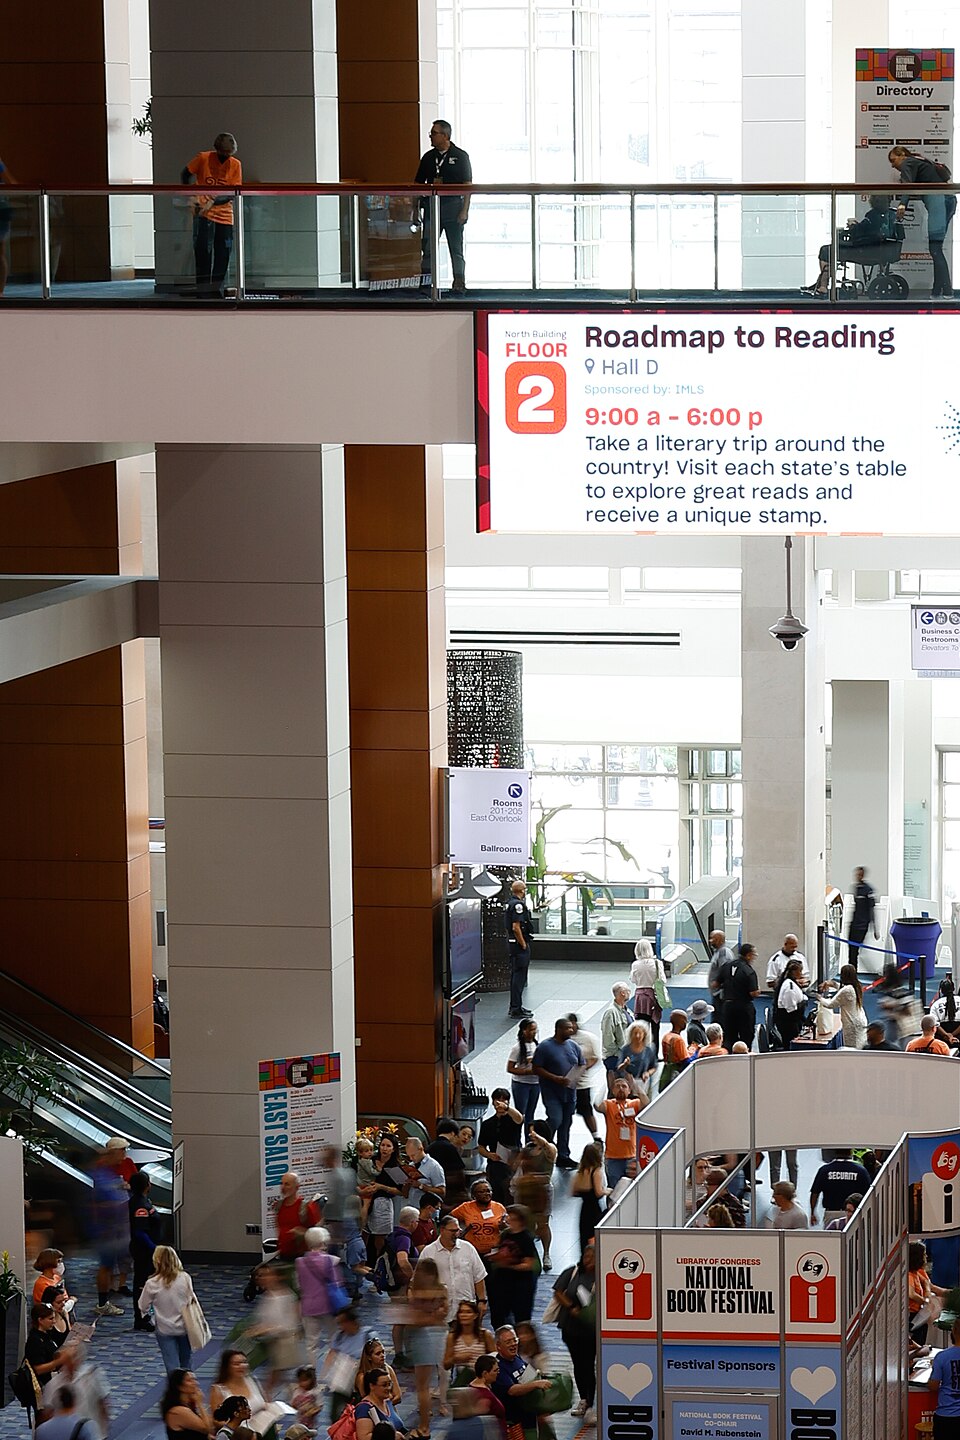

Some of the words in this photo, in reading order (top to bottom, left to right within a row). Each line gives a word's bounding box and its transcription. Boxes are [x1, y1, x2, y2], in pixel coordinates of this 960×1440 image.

[876, 85, 934, 98] Directory
[505, 330, 530, 338] North
[532, 330, 567, 340] Building
[585, 325, 725, 354] Roadmap
[734, 326, 764, 348] to
[775, 324, 895, 355] Reading
[506, 343, 568, 358] FLOOR
[602, 359, 639, 375] Hall
[646, 359, 659, 375] D
[516, 374, 555, 423] 2
[584, 384, 649, 396] Sponsored
[653, 384, 671, 396] by:
[676, 384, 704, 395] IMLS
[585, 408, 639, 426] 9:00
[647, 412, 660, 426] a
[687, 408, 740, 426] 6:00
[748, 412, 764, 430] p
[585, 436, 630, 452] Take
[637, 440, 648, 452] a
[656, 435, 726, 456] literary
[733, 436, 768, 456] trip
[775, 436, 846, 452] around
[852, 436, 885, 452] the
[585, 460, 669, 480] country!
[676, 460, 718, 476] Visit
[725, 460, 774, 476] each
[781, 460, 848, 476] state’s
[856, 460, 907, 476] table
[586, 485, 606, 500] to
[612, 483, 686, 504] explore
[693, 485, 746, 504] great
[752, 484, 808, 500] reads
[816, 484, 852, 500] and
[586, 508, 660, 524] receive
[667, 511, 678, 524] a
[685, 508, 752, 528] unique
[759, 510, 827, 528] stamp.
[470, 814, 487, 822] East
[488, 814, 522, 823] Overlook
[480, 844, 522, 853] Ballrooms
[264, 1091, 288, 1131] EAST
[264, 1134, 290, 1188] SALON
[828, 1172, 858, 1180] SECURITY
[472, 1222, 494, 1236] 25
[685, 1266, 754, 1290] NATIONAL
[666, 1290, 707, 1313] BOOK
[711, 1290, 775, 1314] FESTIVAL
[808, 1285, 818, 1319] i
[666, 1359, 716, 1370] Festival
[718, 1360, 776, 1373] Sponsors
